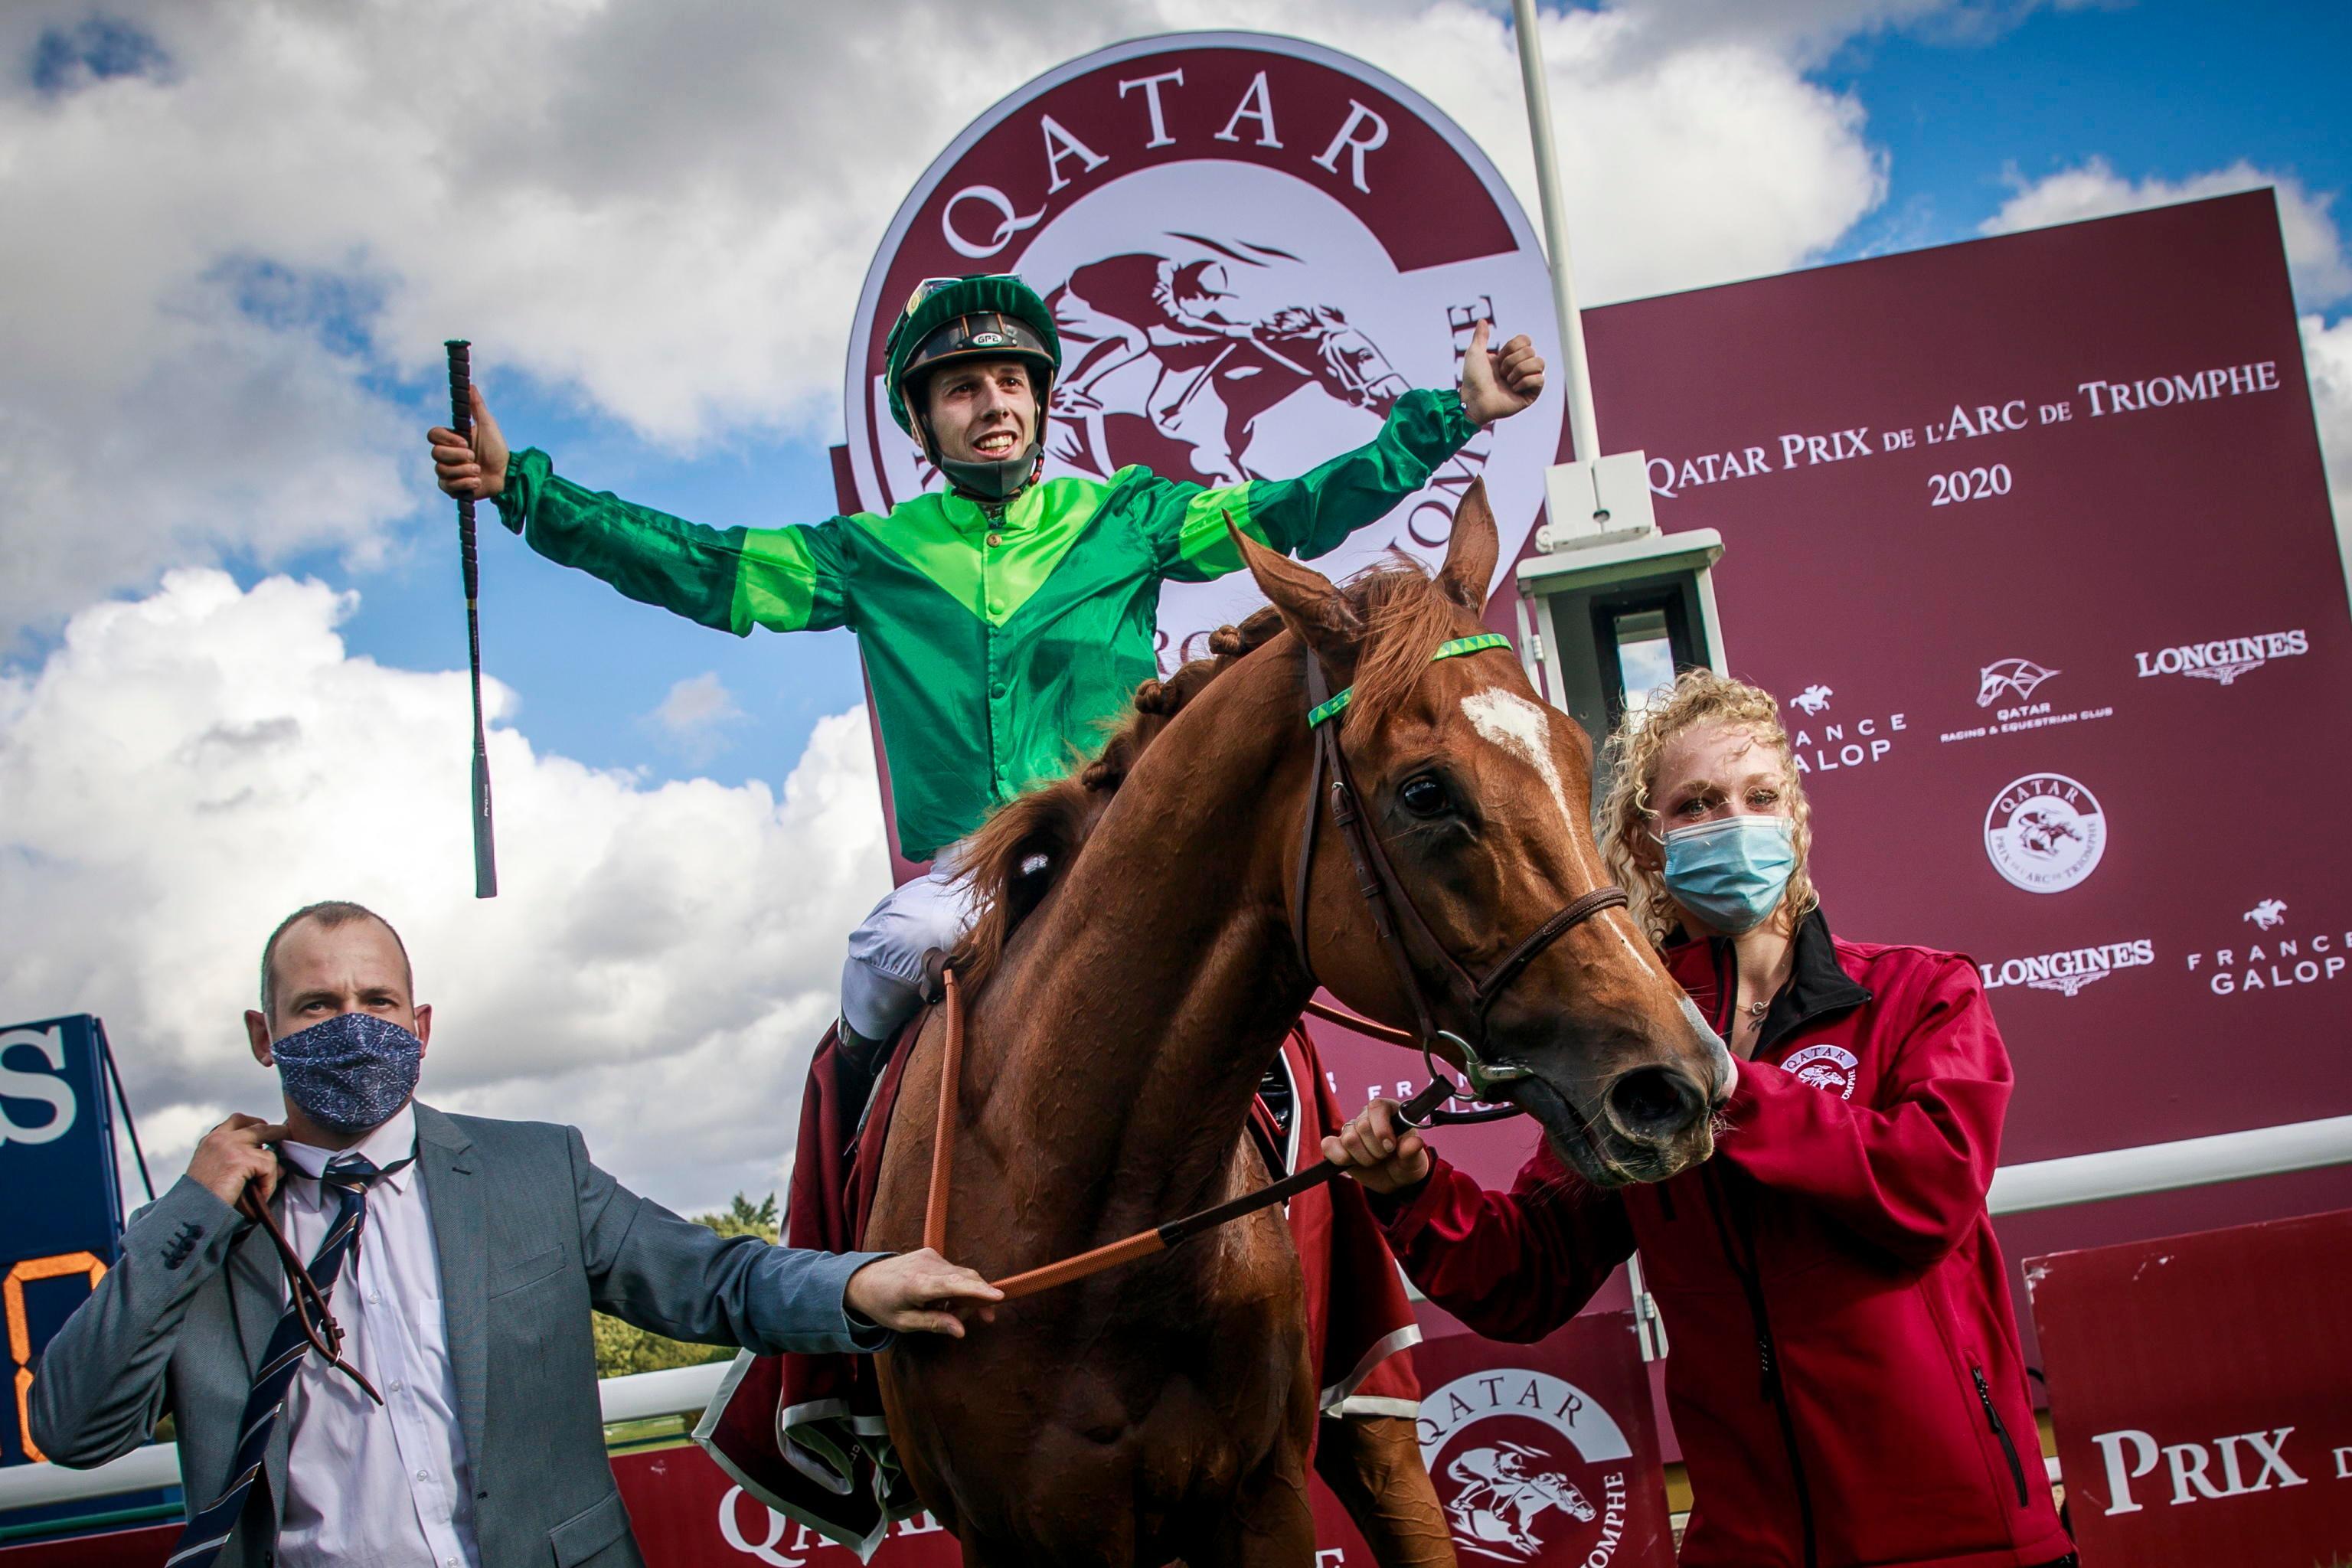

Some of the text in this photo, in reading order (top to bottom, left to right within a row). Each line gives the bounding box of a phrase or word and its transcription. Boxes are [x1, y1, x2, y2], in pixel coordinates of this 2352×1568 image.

[942, 68, 1389, 259] QATAR
[1646, 361, 2280, 498] QATAR PRIX DE L'ARC DE TRIOMPHE
[1927, 463, 2012, 506] 2020
[2135, 629, 2309, 678] LONGINES
[1795, 713, 1907, 747] ANCE
[1997, 702, 2051, 721] QATAR
[2001, 713, 2077, 733] EQUESTRIAN
[2080, 707, 2113, 721] CLUB
[1793, 739, 1891, 773] ALOP
[2000, 779, 2079, 813] QATAR
[1979, 939, 2155, 989] LONGINES
[2211, 956, 2346, 995] GALOP
[1787, 1047, 1846, 1070] QATAR
[1416, 1377, 1583, 1446] QATAR
[2091, 1426, 2309, 1517] PRIX
[1582, 1472, 1627, 1568] OMPHE
